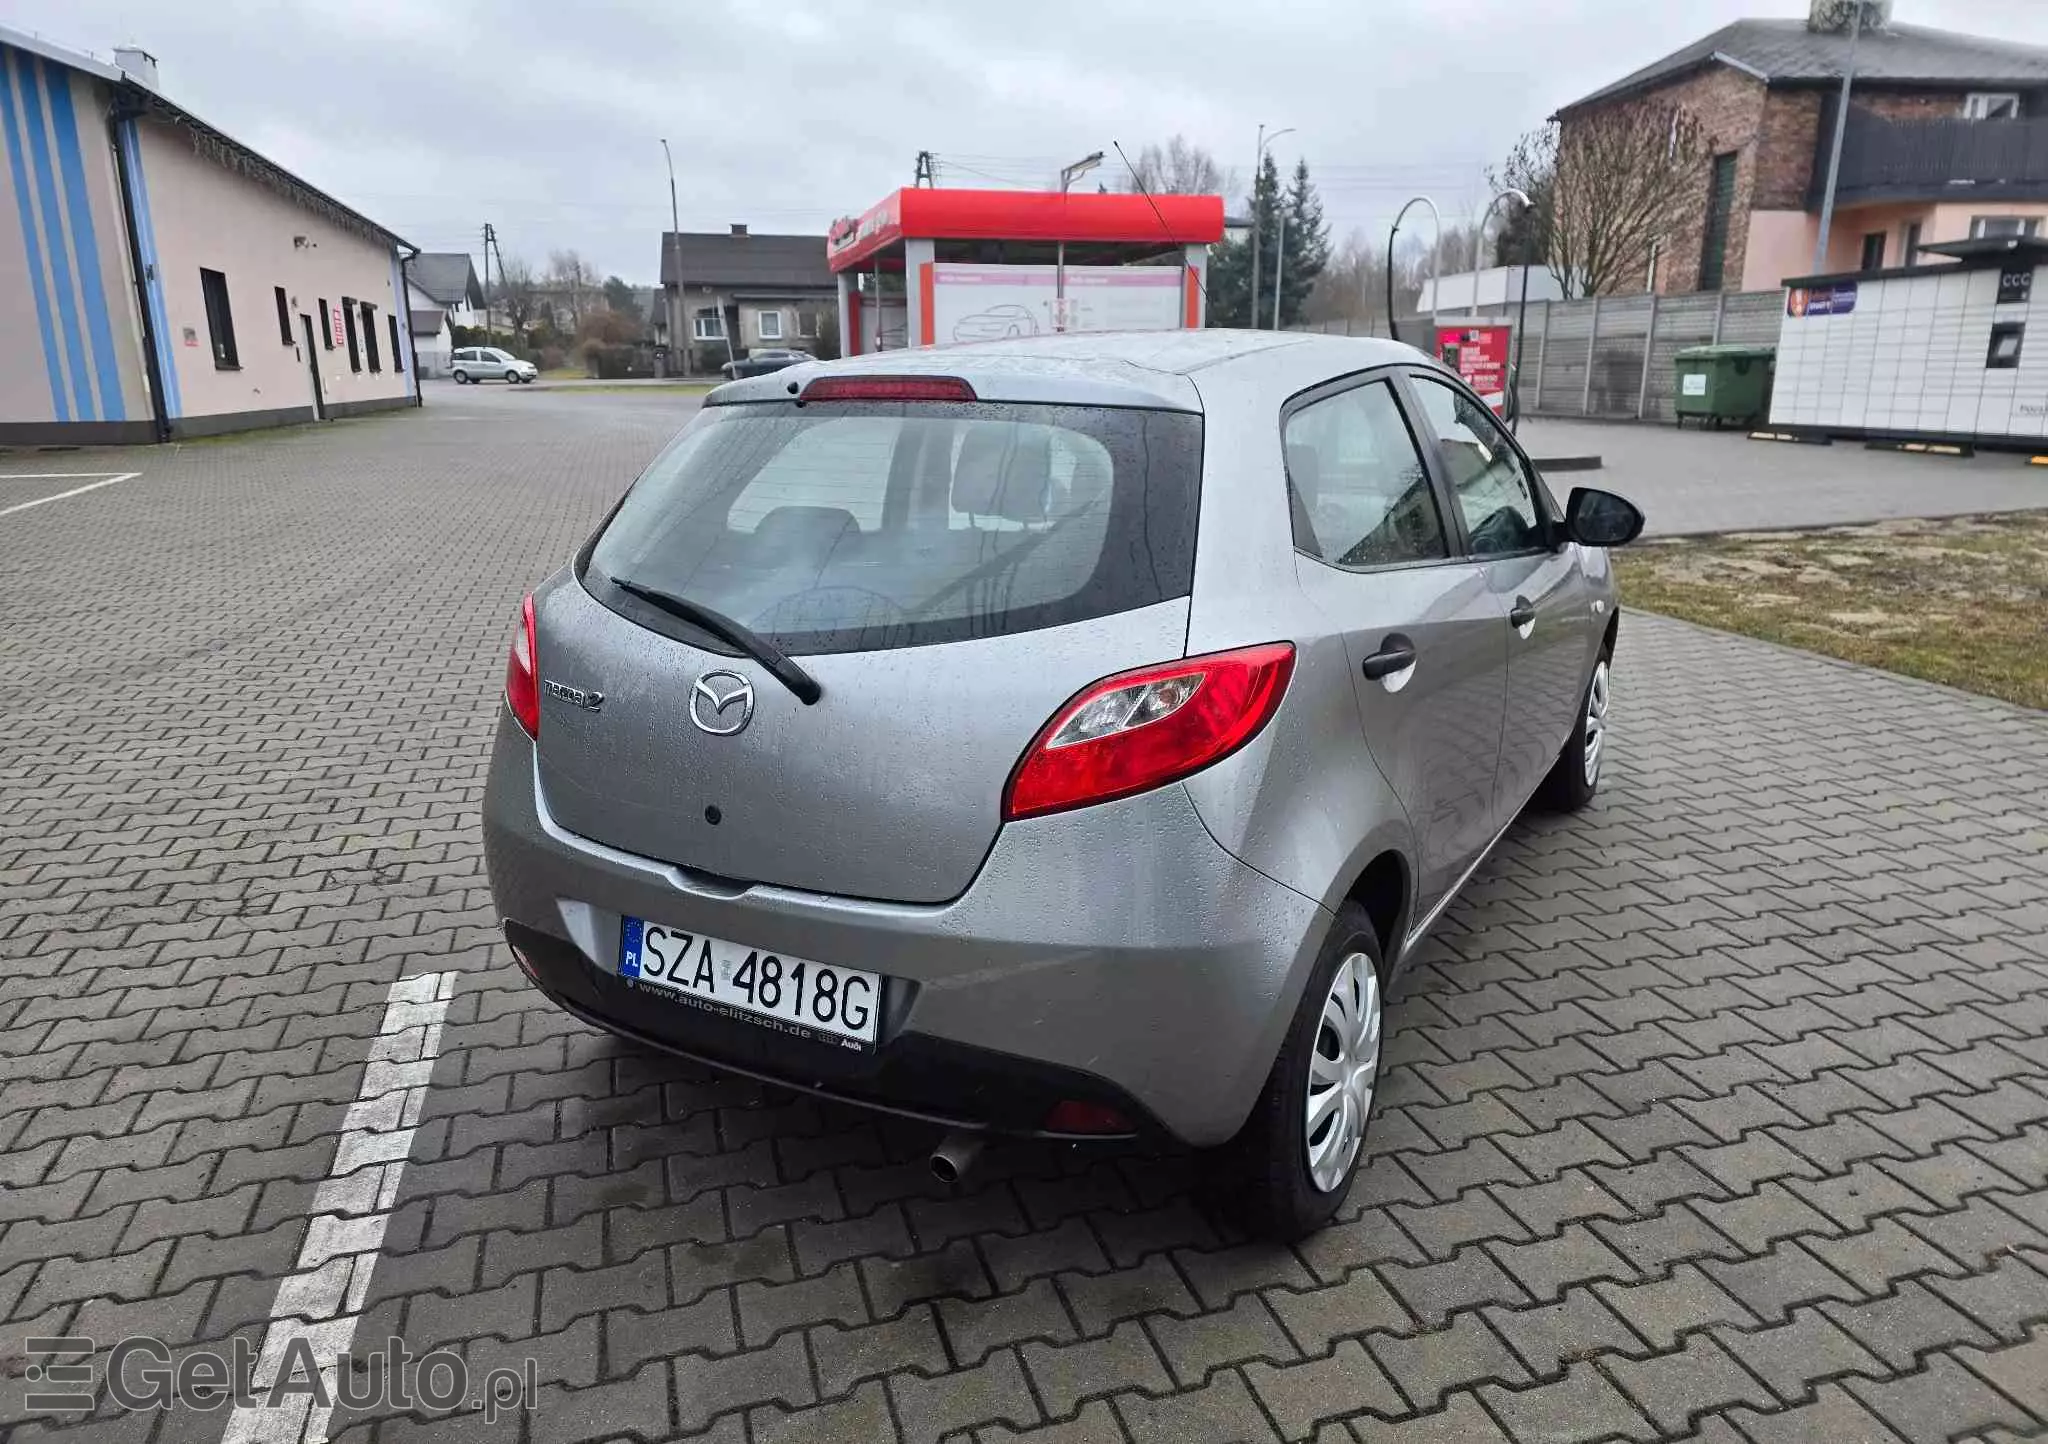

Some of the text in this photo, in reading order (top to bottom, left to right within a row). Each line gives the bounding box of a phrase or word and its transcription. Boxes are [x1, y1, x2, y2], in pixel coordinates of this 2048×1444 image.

[2002, 272, 2031, 287] CCC
[625, 951, 638, 967] PL
[643, 926, 871, 1030] SZA 4818G
[639, 983, 812, 1039] www.auto-elitzsch.de
[841, 1038, 863, 1051] Audi
